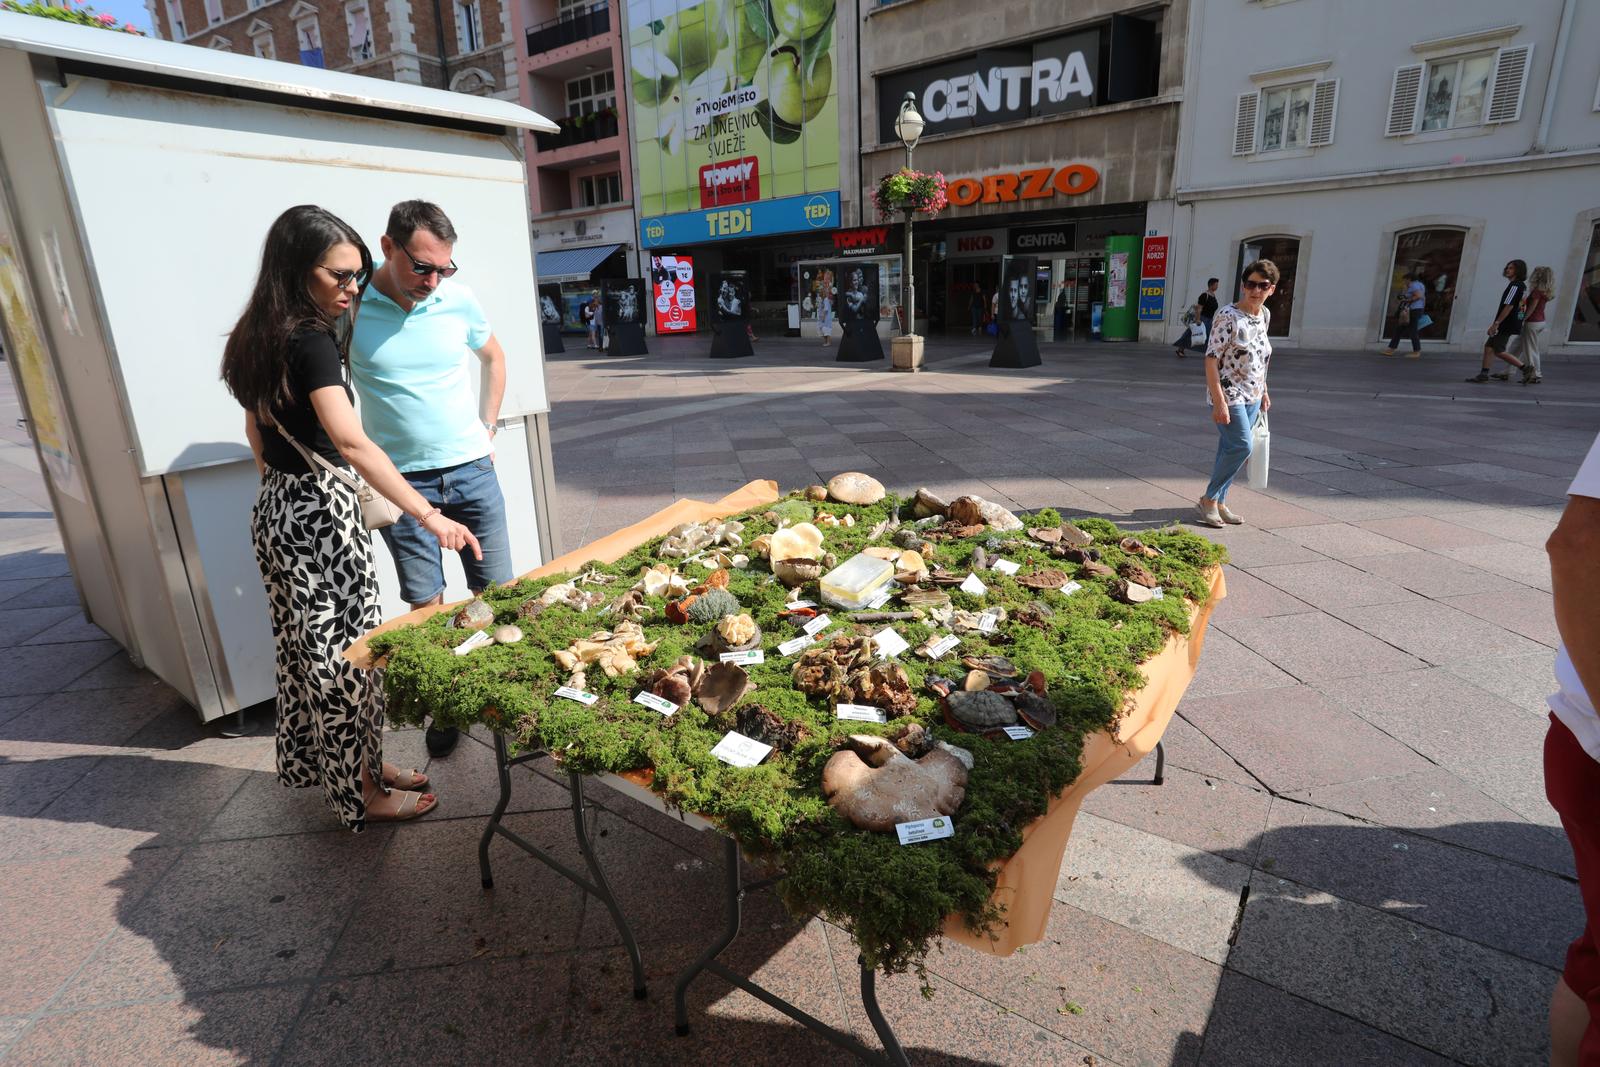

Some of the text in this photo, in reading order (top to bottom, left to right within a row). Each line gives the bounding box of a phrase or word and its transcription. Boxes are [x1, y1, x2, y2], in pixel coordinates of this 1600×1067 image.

[922, 51, 1093, 122] CENTRA
[694, 124, 707, 141] ZA
[708, 133, 746, 158] SVJEŽE
[703, 161, 754, 188] TOMMY
[938, 164, 1099, 207] ORZO
[804, 203, 831, 220] TEDi
[706, 208, 752, 237] TEDi
[646, 225, 665, 239] TEDi
[832, 227, 888, 248] TOMMY
[1017, 231, 1066, 248] CENTRA
[843, 247, 875, 255] MAXIMARKET
[957, 235, 994, 251] NKD
[1147, 244, 1165, 252] OPTIKA
[1146, 252, 1165, 260] KORZO
[1141, 287, 1164, 296] TEDi
